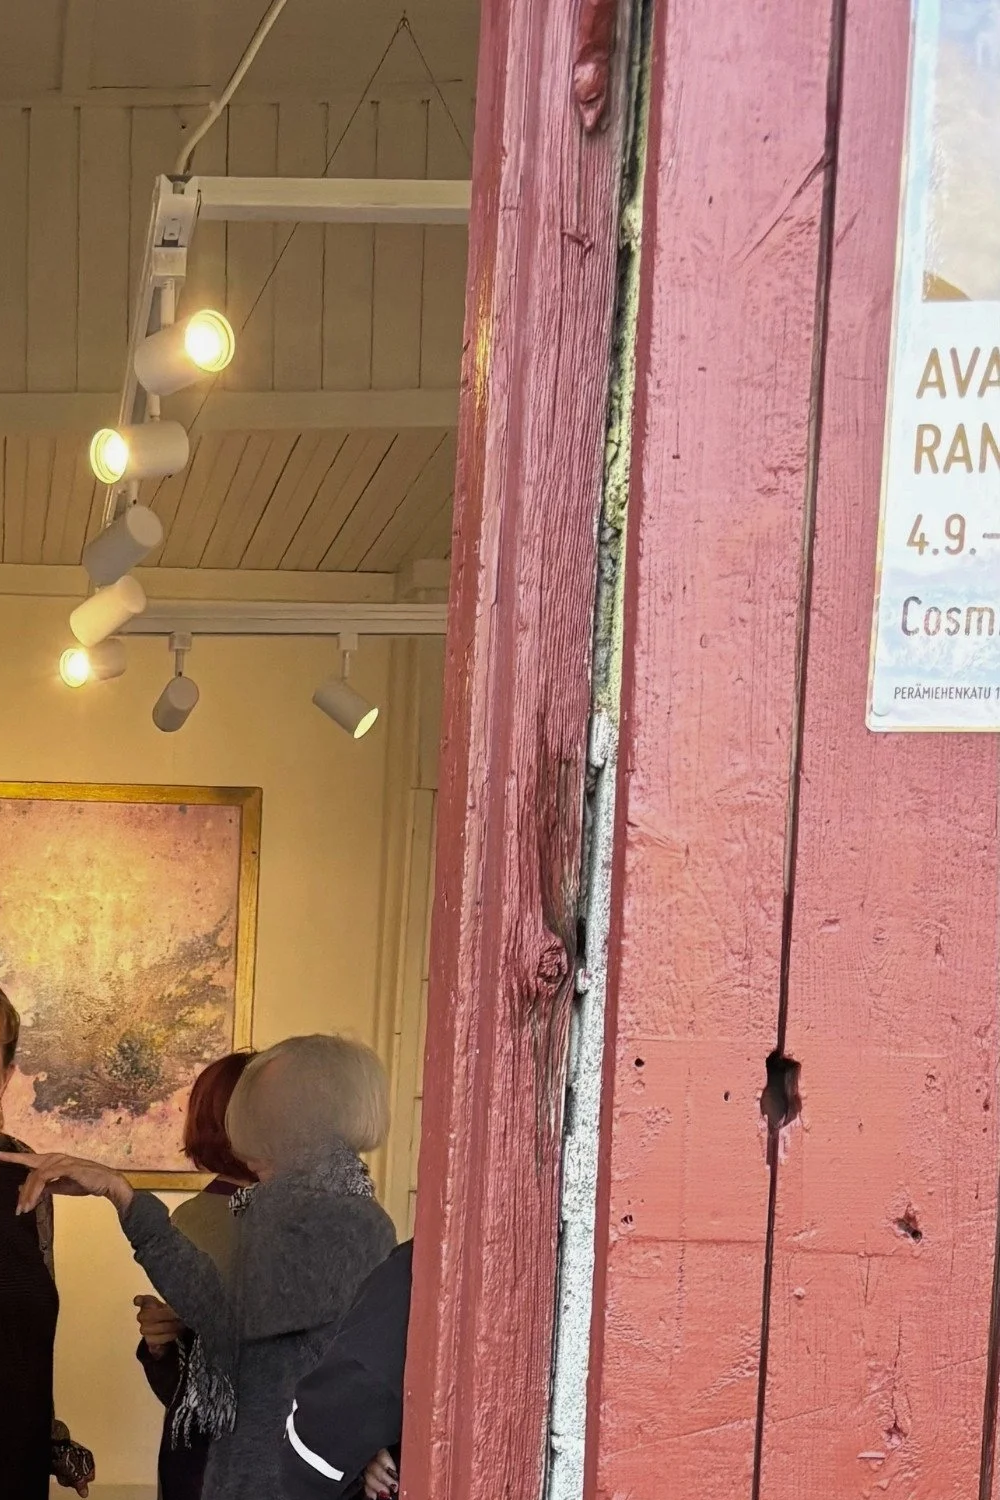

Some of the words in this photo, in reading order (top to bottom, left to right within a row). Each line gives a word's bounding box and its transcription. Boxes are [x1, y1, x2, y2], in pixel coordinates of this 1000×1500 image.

[915, 346, 1000, 399] AVA
[914, 422, 1000, 474] RAN
[901, 596, 1000, 637] Cosm
[893, 683, 991, 700] PERÄMIEHENKATU
